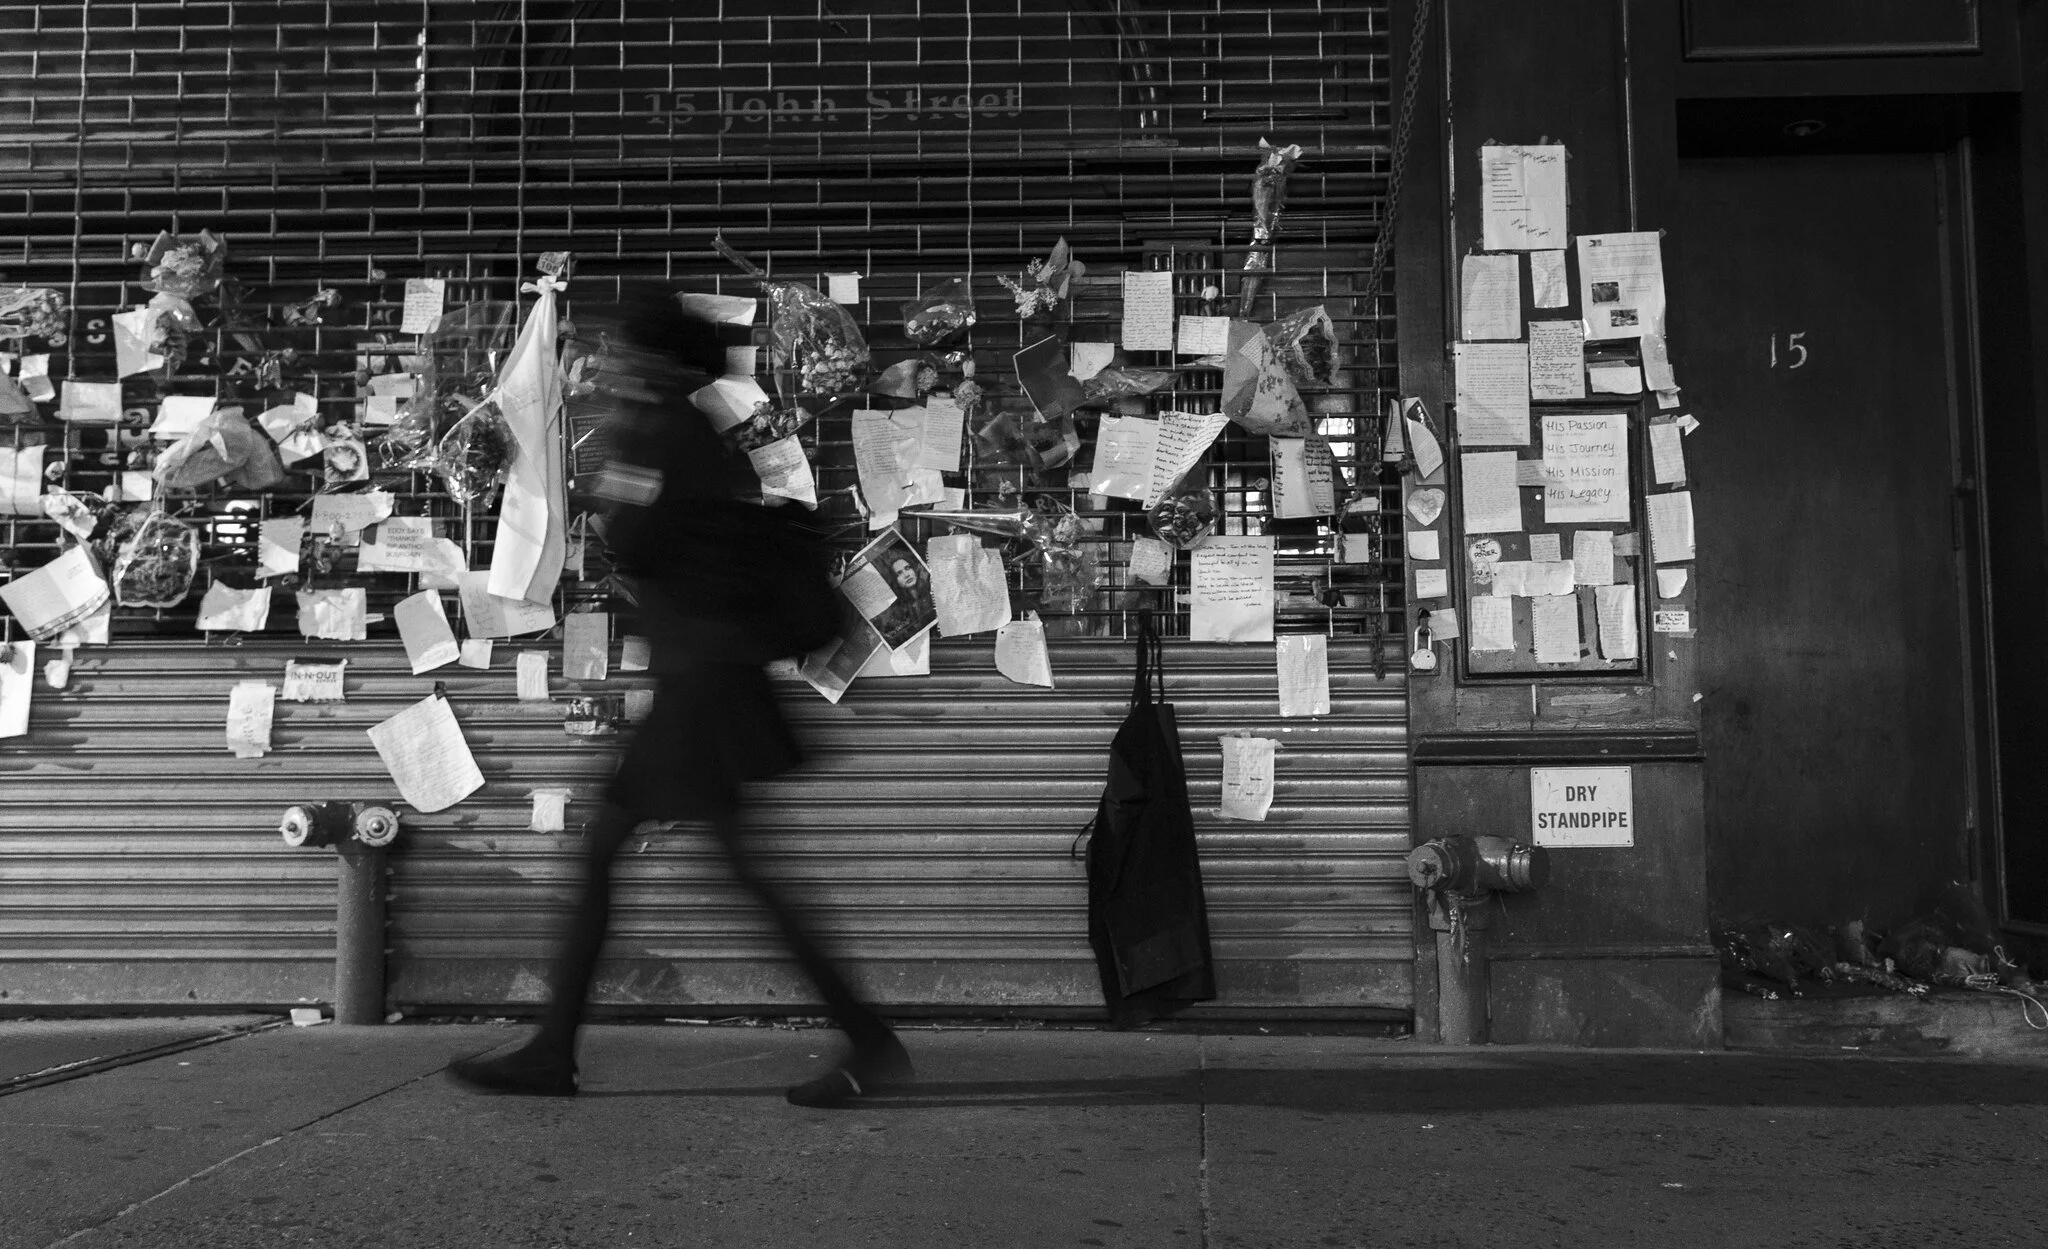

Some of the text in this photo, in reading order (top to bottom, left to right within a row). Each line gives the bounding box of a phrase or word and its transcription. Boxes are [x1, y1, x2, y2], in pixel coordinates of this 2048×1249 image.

[644, 88, 1021, 133] 15 John Street
[1770, 331, 1808, 369] 15
[1569, 443, 1615, 457] Journey
[1570, 465, 1615, 477] Mission
[1569, 488, 1611, 504] Legacy
[1566, 785, 1598, 802] DRY
[1538, 812, 1628, 829] STANDPIPE
